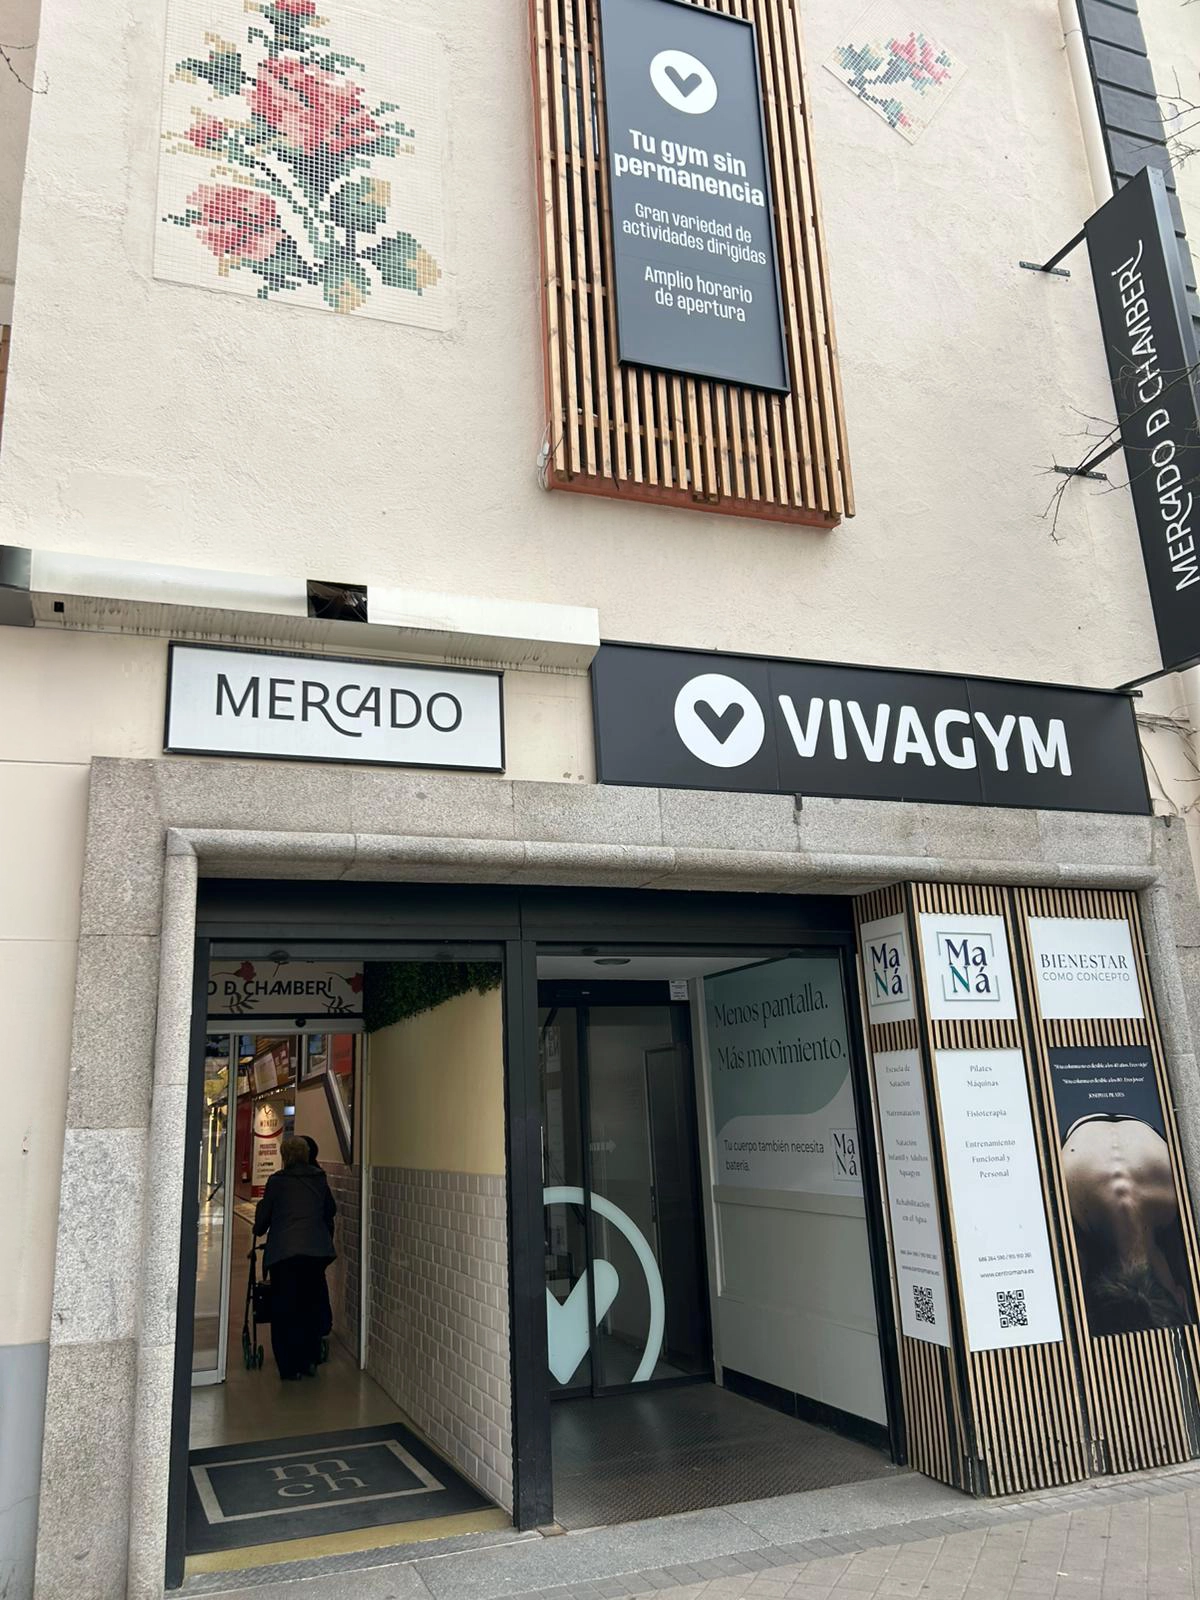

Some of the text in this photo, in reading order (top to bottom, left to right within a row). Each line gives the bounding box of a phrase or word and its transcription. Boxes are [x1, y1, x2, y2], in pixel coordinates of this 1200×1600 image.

[629, 129, 747, 177] Tu gym sin
[614, 152, 765, 207] permanencia
[635, 202, 752, 243] Gran variedad de
[622, 220, 767, 265] actividades dirigidas
[644, 266, 753, 304] Amplio horario
[655, 287, 746, 322] de apertura
[1111, 239, 1164, 404] CHAMBERÍ
[1151, 439, 1200, 592] MERCADO
[216, 673, 463, 738] MERCADO
[778, 694, 1072, 776] VIVAGYM
[871, 943, 900, 972] Ma
[945, 939, 988, 966] Ma
[1040, 953, 1128, 969] BIENESTAR
[243, 976, 337, 999] CHAMBERÍ
[950, 966, 991, 993] Ná
[1042, 971, 1130, 982] COMO CONCEPTO
[714, 983, 828, 1028] Menos pantalla.
[718, 1036, 846, 1071] Más movimiento.
[969, 1065, 992, 1073] Pilates
[966, 1109, 1007, 1119] Fisioterapia
[724, 1139, 825, 1153] Tu cuerpo también necesita
[964, 1140, 1016, 1149] Entrenamiento
[972, 1154, 1005, 1164] Funcional
[979, 1169, 1010, 1179] Personal
